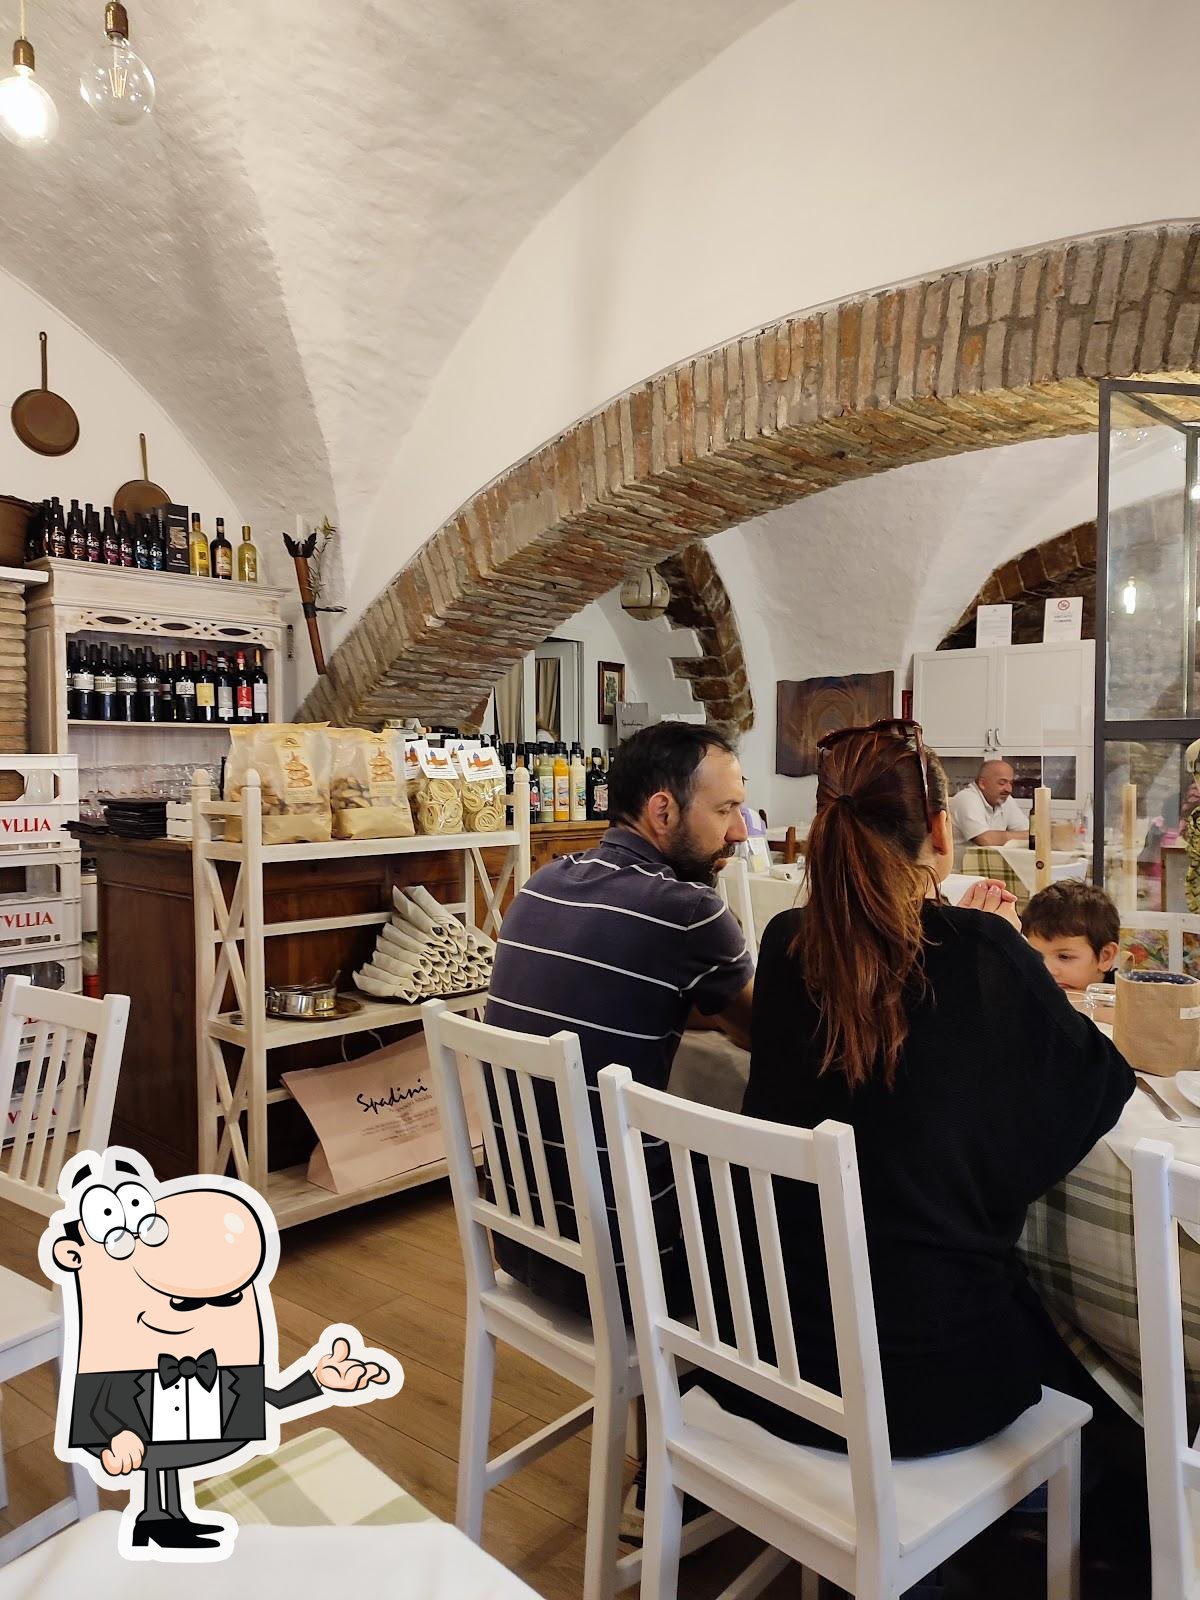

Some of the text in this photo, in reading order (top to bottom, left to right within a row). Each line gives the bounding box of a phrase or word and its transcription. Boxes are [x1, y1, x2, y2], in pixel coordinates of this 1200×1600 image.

[0, 818, 51, 832] VLLIA
[0, 912, 54, 928] VLLIA
[357, 1078, 428, 1115] Spadini
